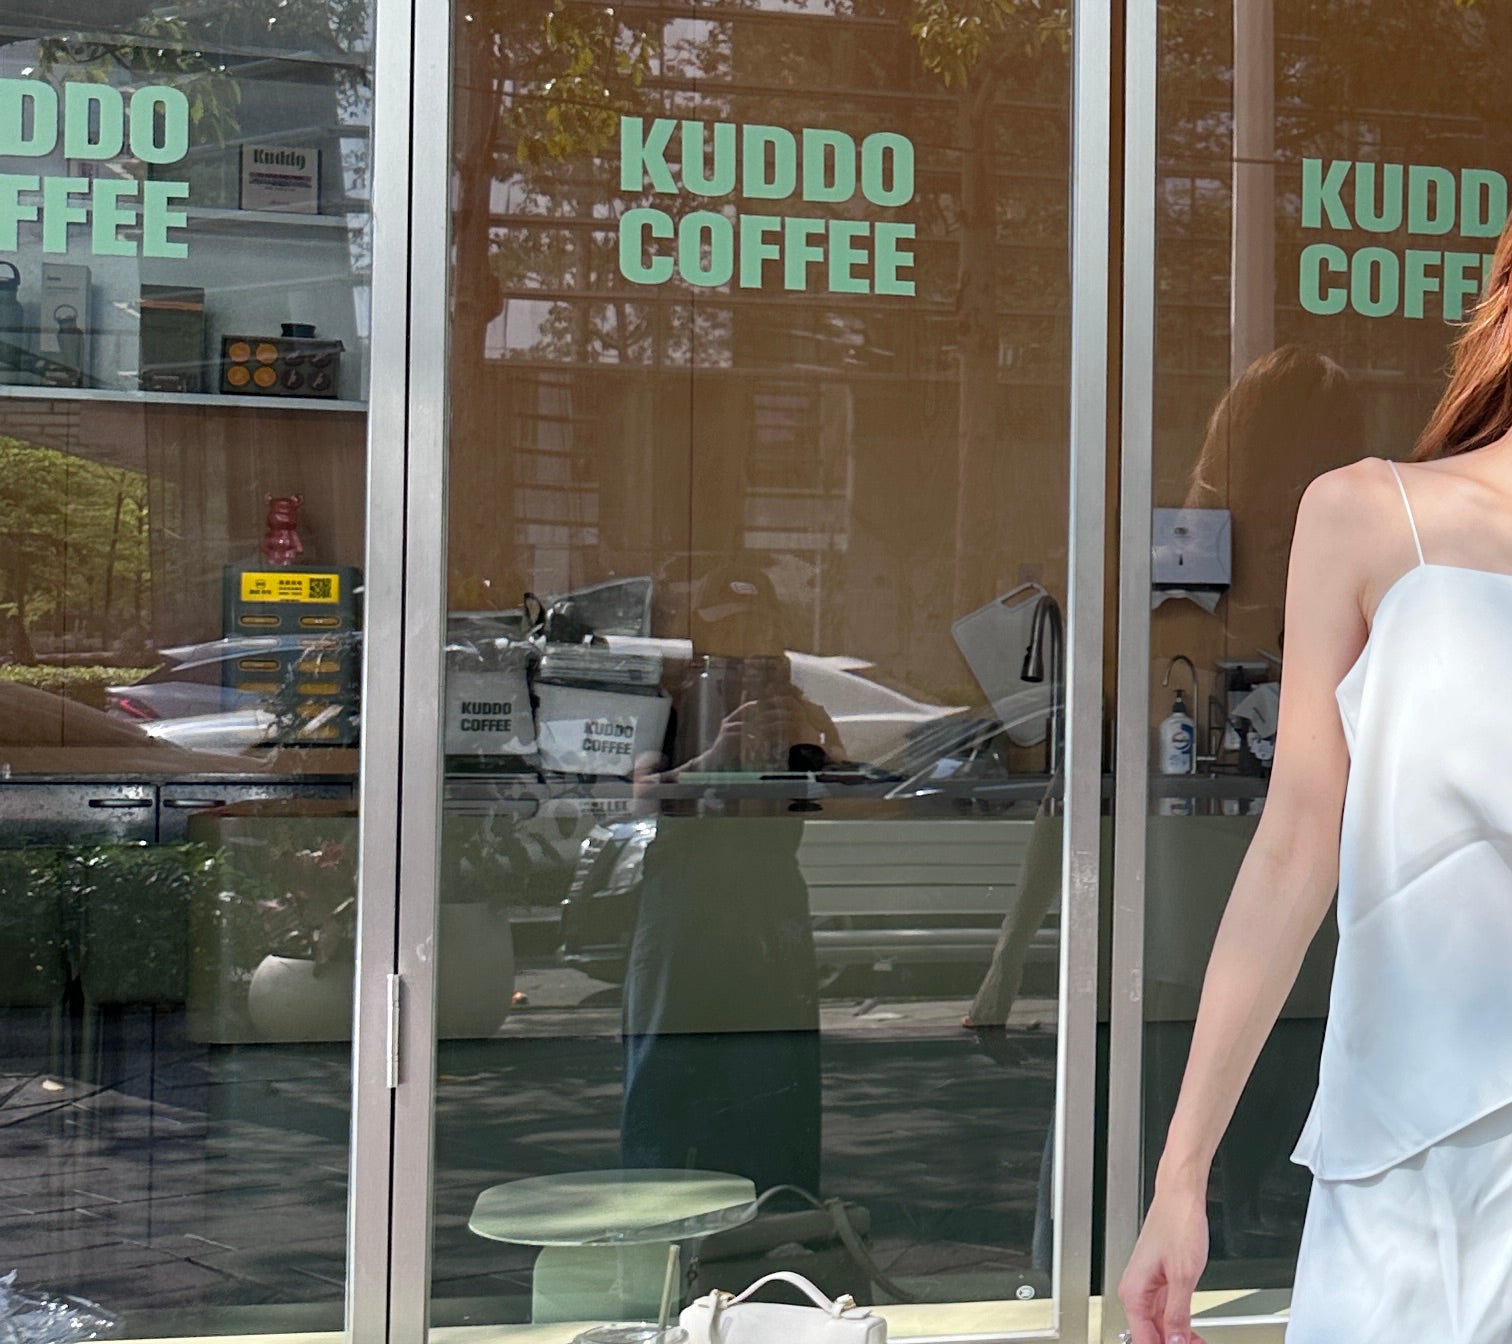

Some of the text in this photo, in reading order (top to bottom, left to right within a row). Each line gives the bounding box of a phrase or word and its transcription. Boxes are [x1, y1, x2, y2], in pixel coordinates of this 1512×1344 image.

[620, 115, 915, 207] KUDDO
[618, 207, 916, 296] COFFEE
[461, 702, 512, 715] KUDDO
[460, 719, 512, 732] COFFEE
[583, 720, 634, 738] KUDDO
[582, 738, 633, 755] COFFEE
